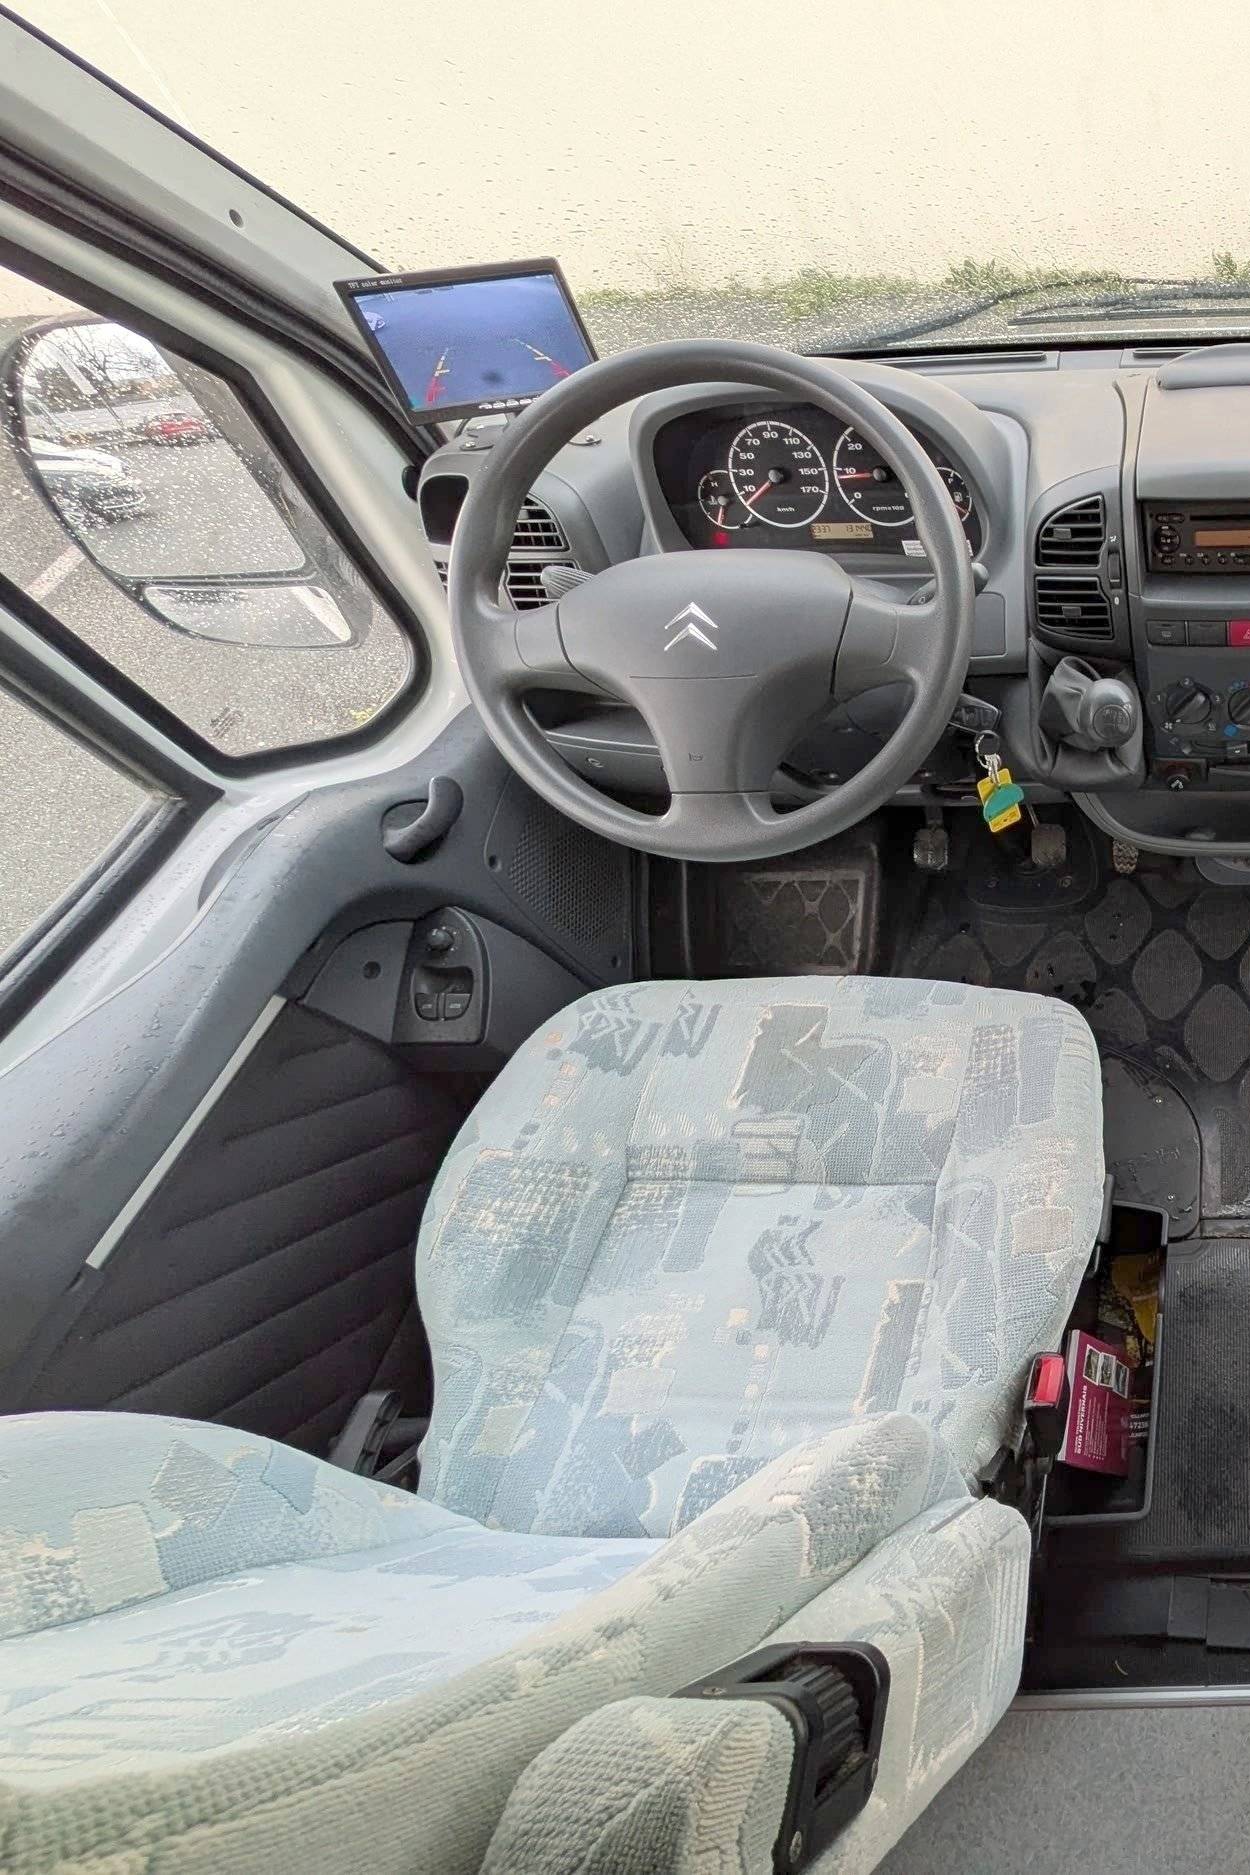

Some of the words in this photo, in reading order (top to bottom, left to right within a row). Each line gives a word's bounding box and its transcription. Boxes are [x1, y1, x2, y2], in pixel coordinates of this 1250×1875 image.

[762, 431, 779, 439] 90
[745, 438, 761, 446] 70
[782, 437, 801, 445] 110
[847, 442, 863, 451] 20
[739, 452, 755, 460] 50
[792, 451, 812, 459] 130
[739, 468, 755, 476] 30
[798, 467, 818, 475] 150
[843, 467, 857, 475] 10
[743, 484, 756, 492] 10
[800, 485, 819, 493] 170
